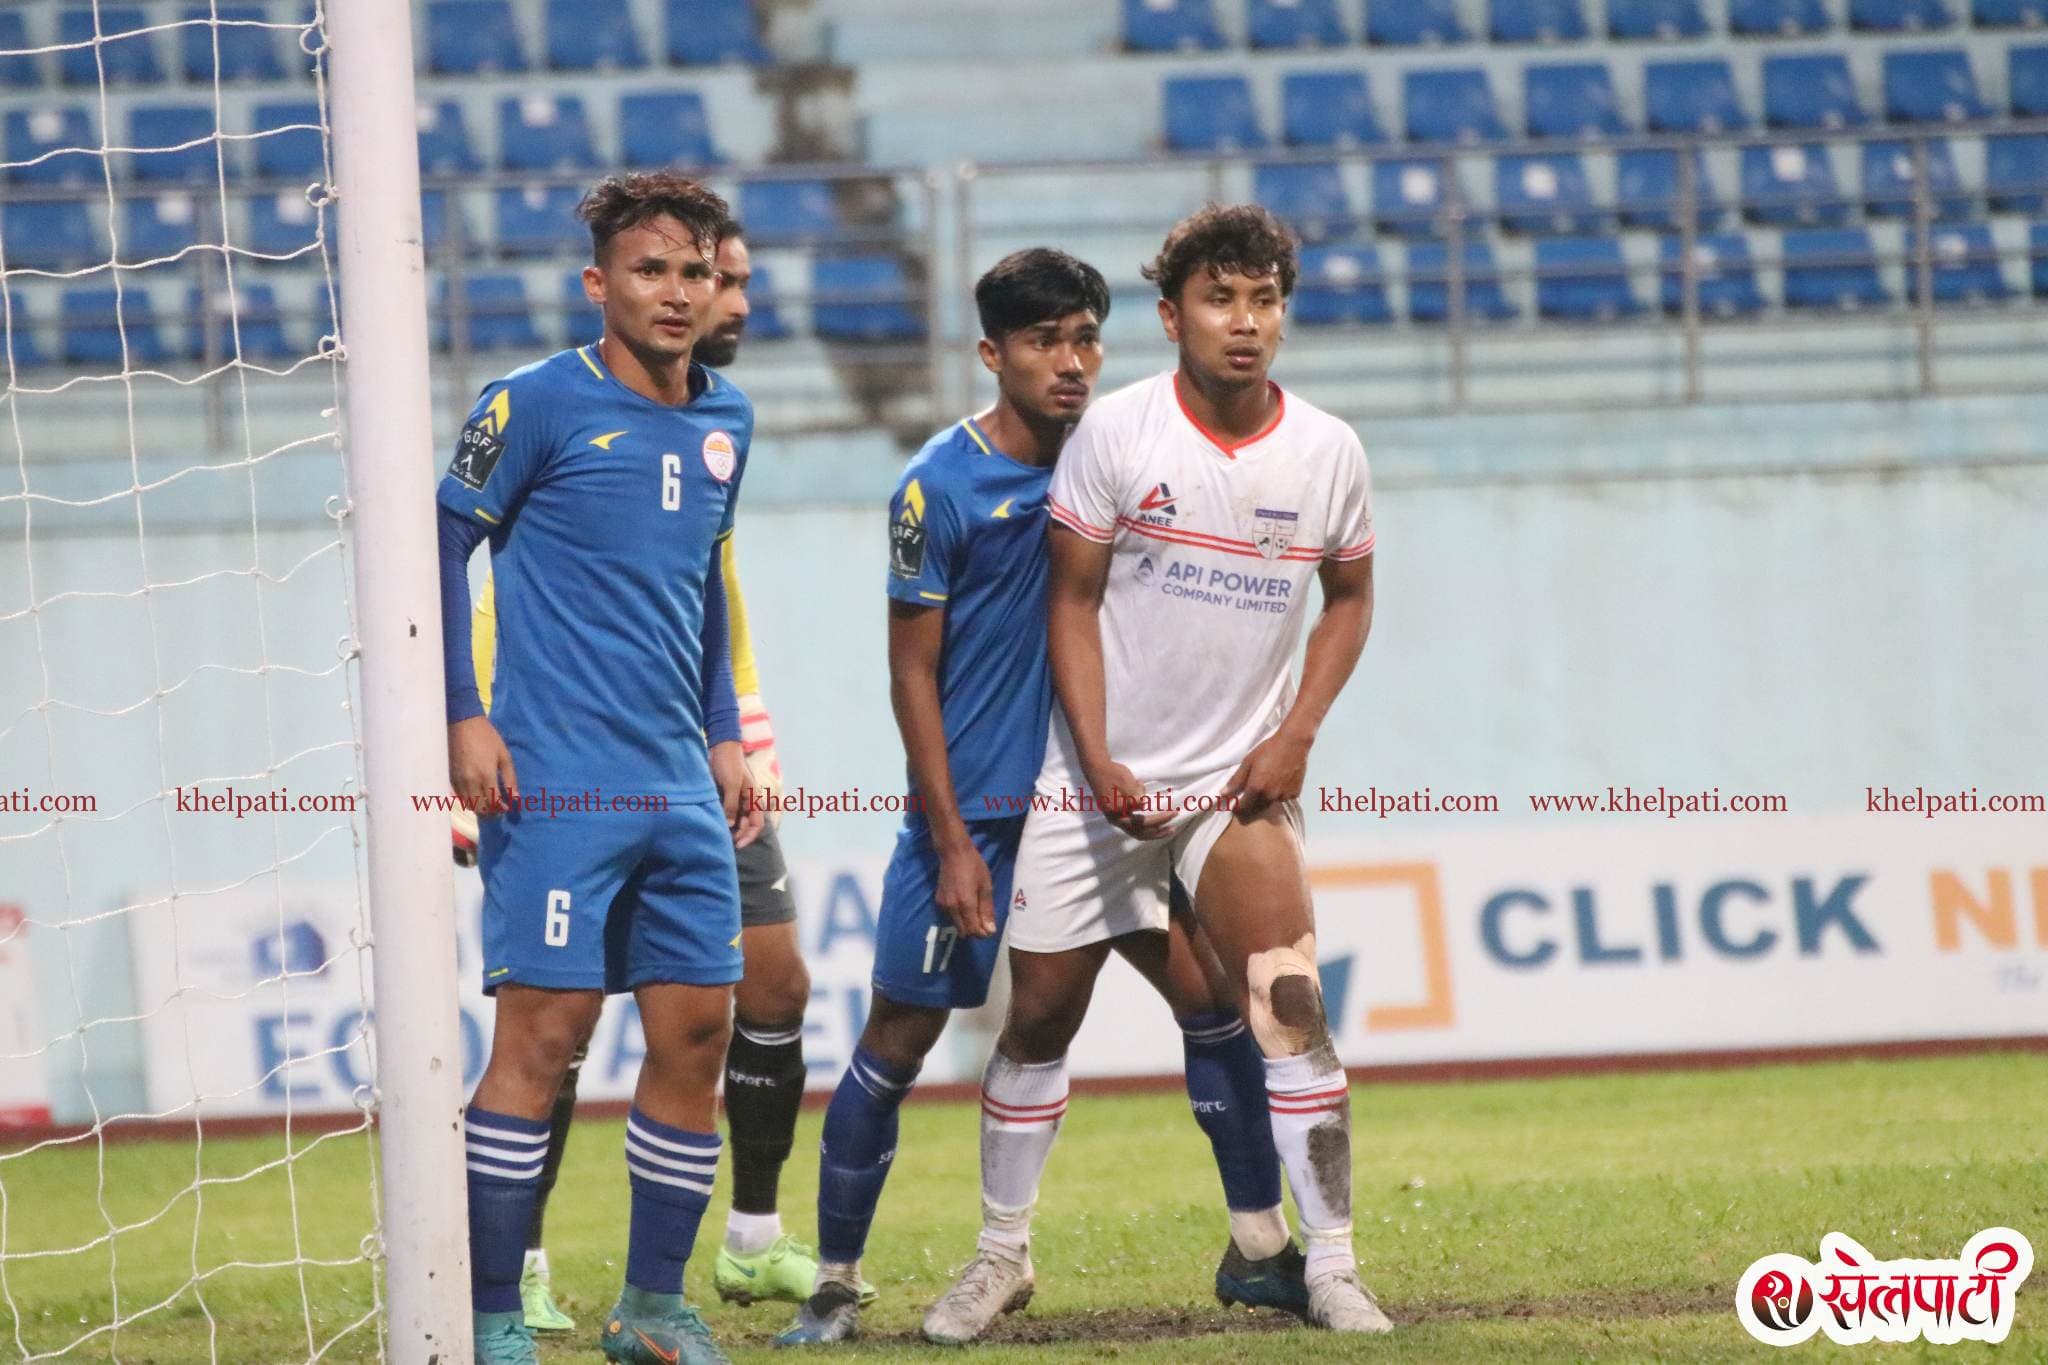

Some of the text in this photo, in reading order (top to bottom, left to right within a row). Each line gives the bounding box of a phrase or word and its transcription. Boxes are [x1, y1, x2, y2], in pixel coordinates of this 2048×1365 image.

[662, 454, 681, 511] 6
[1139, 513, 1173, 527] ANEE
[1161, 583, 1287, 613] COMPANY LIMITED
[1165, 561, 1292, 598] API POWER
[544, 890, 570, 947] 6
[1476, 872, 1883, 967] CLICK
[923, 926, 957, 973] 17
